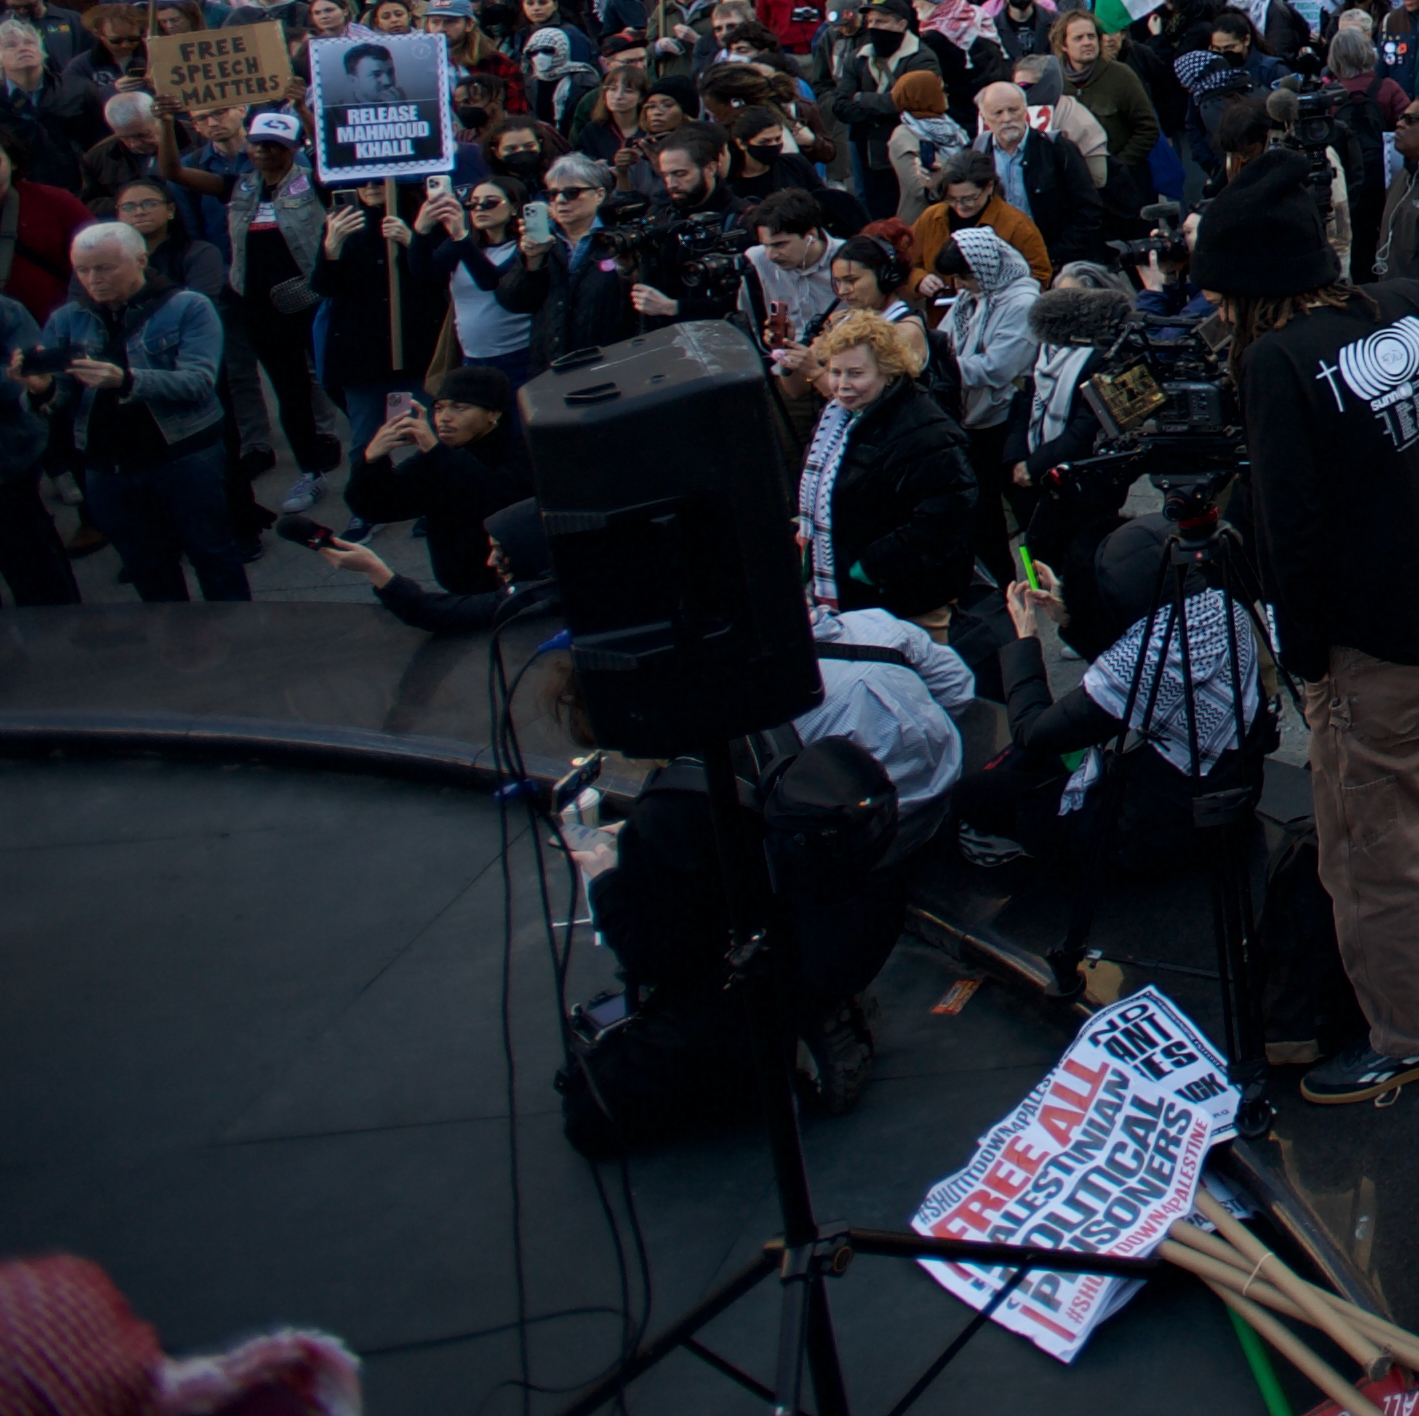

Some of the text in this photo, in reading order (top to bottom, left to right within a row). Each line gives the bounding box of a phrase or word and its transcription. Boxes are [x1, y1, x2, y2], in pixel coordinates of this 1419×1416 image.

[179, 36, 246, 63] FREE
[170, 58, 259, 85] SPEECH
[181, 75, 279, 106] MATTERS
[348, 105, 418, 124] RELEASE
[337, 122, 429, 143] MAHMOUD
[356, 139, 414, 159] KHALIL
[1036, 1058, 1111, 1150] ALL
